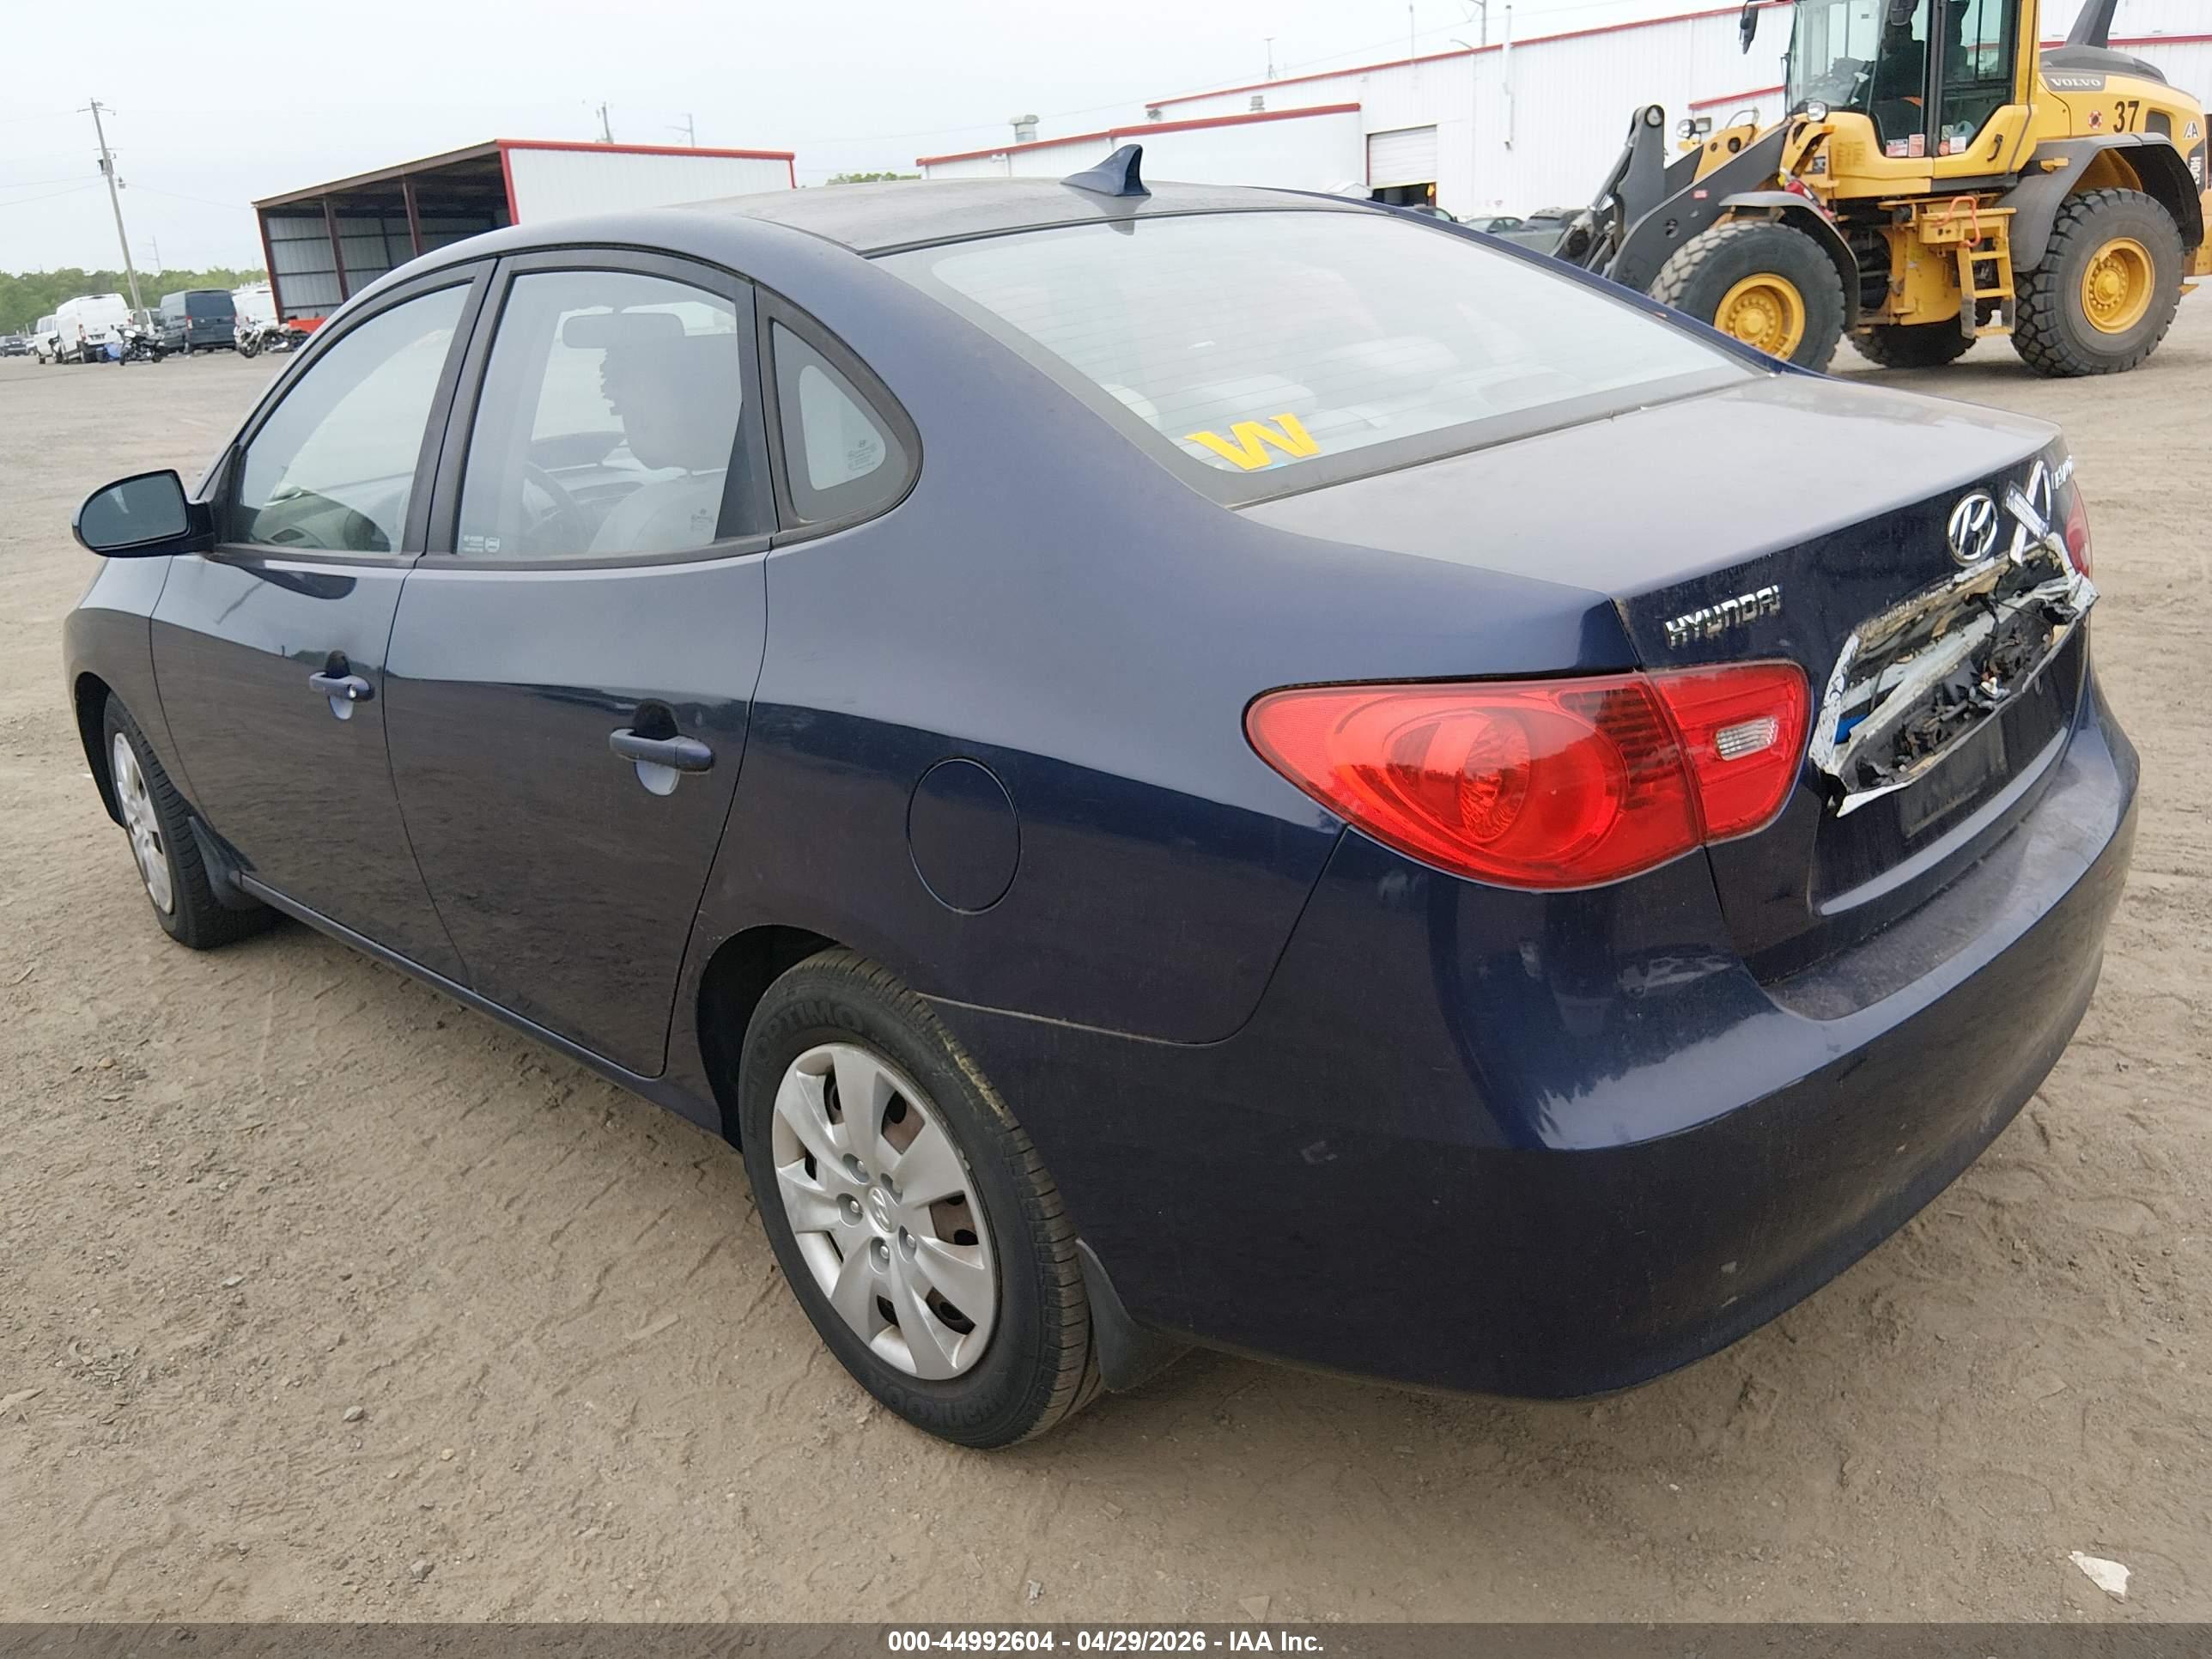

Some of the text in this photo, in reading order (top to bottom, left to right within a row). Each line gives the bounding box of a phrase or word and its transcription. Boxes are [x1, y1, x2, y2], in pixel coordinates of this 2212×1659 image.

[2050, 77, 2101, 88] VOLVO
[2113, 100, 2140, 133] 37
[1183, 412, 1322, 471] W
[1664, 584, 1781, 650] HYUNDAI
[754, 1000, 865, 1066] OPTIMO
